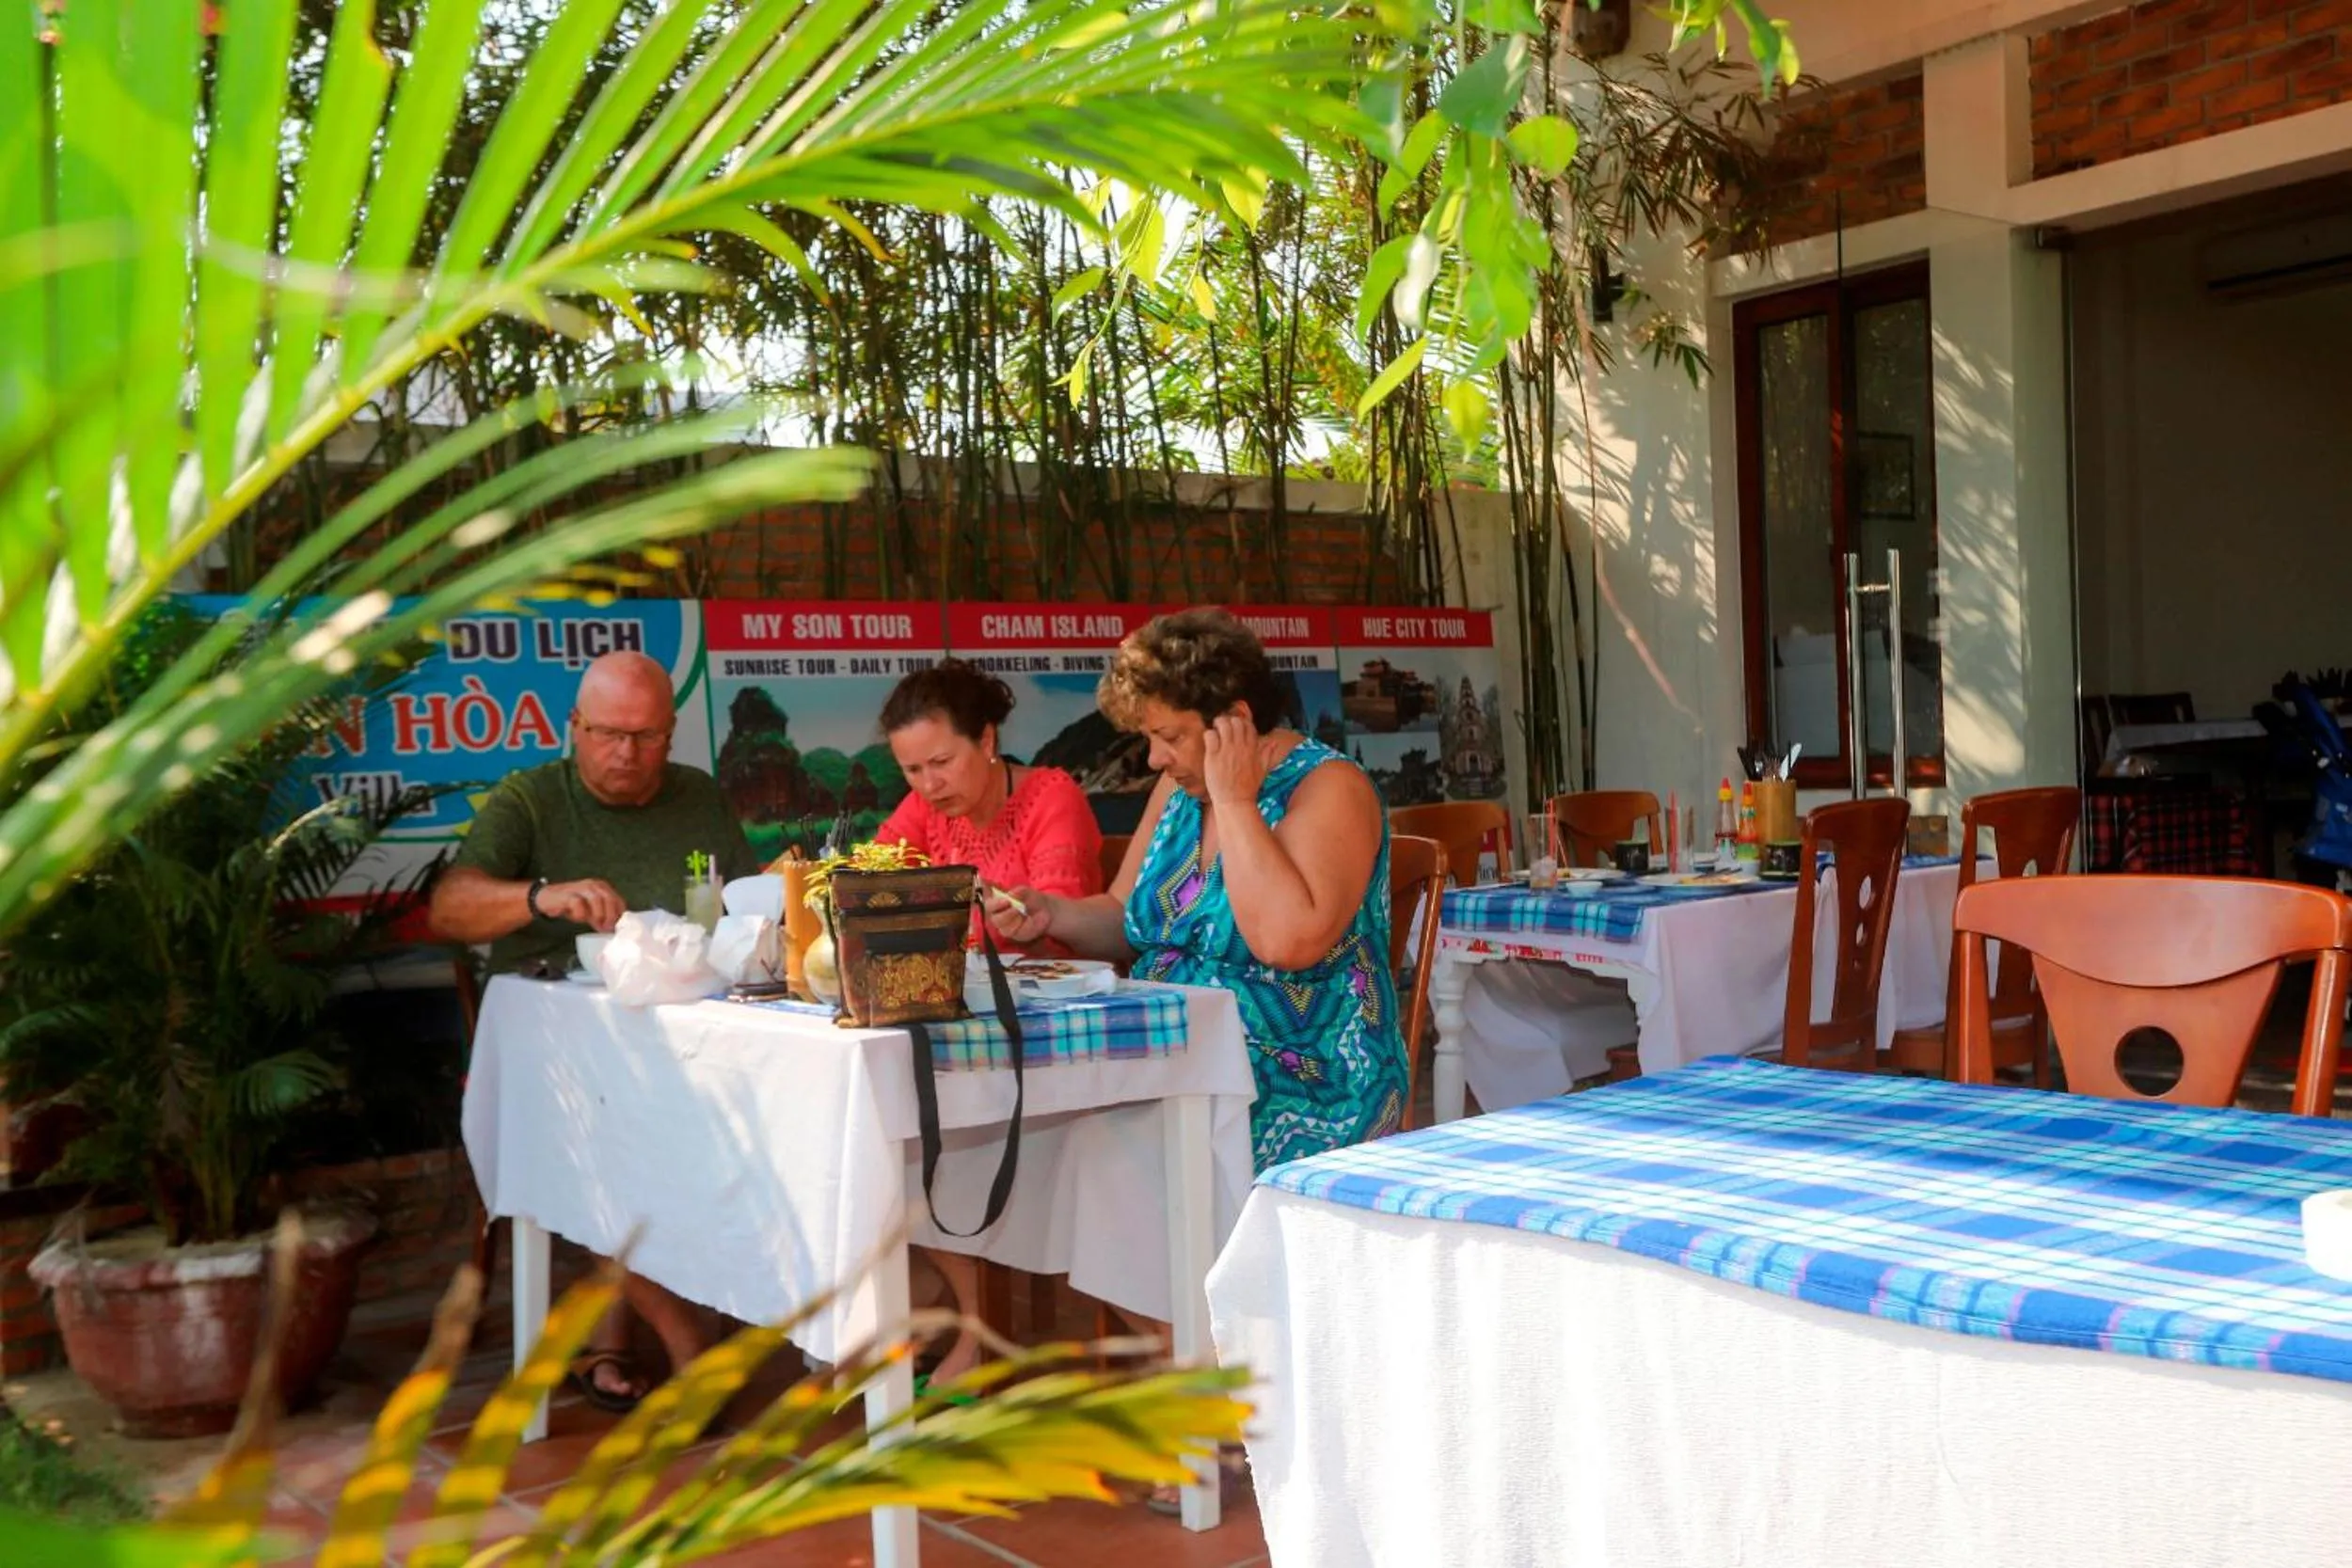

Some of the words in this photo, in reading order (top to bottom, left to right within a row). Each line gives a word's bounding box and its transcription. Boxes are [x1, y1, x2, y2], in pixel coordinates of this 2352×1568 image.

[741, 613, 783, 639] MY
[792, 614, 843, 639] SON
[850, 614, 913, 639] TOUR
[981, 614, 1044, 639] CHAM
[1051, 615, 1124, 639] ISLAND
[1362, 617, 1391, 638] HUE
[1395, 618, 1426, 639] CITY
[1431, 618, 1466, 639] TOUR
[450, 620, 518, 659] DU
[537, 621, 642, 667] LỊCH
[724, 658, 791, 676] SUNRISE
[799, 659, 836, 675] TOUR
[850, 659, 891, 675] DAILY
[971, 657, 1051, 672] NORKELING
[1063, 657, 1104, 671] DIVING
[392, 677, 558, 751] HÒA
